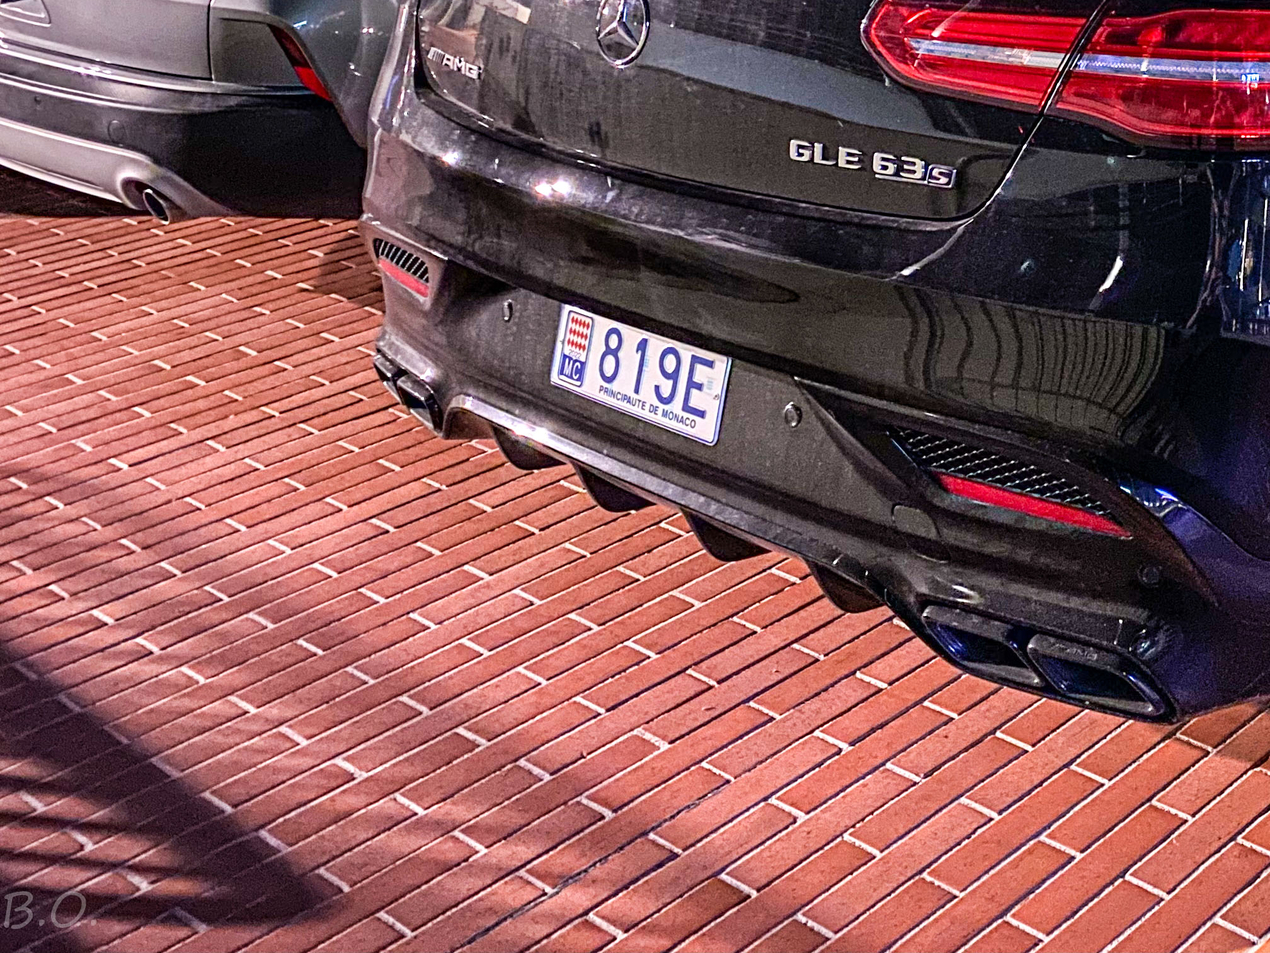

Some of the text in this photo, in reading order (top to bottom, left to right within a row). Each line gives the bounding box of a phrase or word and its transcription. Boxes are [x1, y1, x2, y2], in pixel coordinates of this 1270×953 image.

[442, 53, 482, 81] AMG
[789, 138, 863, 170] GLE
[563, 358, 582, 380] MC
[598, 326, 716, 420] 819E
[598, 384, 697, 429] PRINCIPAUTE DE MONACO
